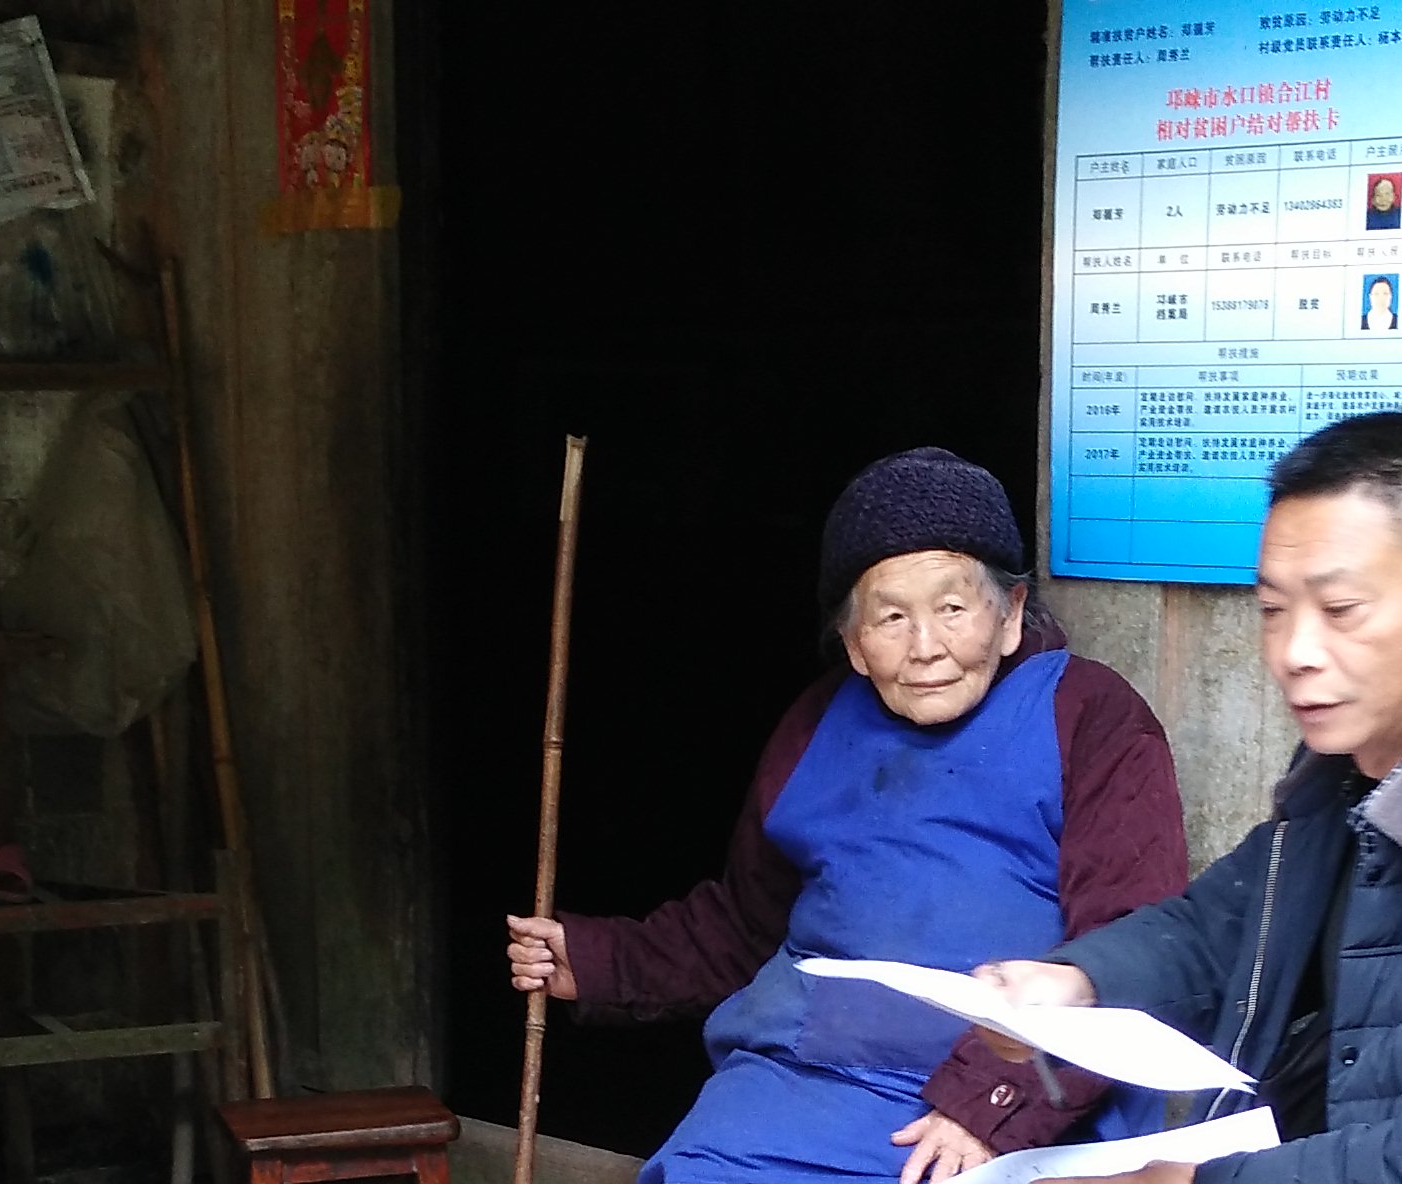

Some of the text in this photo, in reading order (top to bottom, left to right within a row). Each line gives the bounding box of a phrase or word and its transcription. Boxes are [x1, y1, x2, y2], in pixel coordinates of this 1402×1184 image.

[1166, 77, 1331, 110] 邛崃市水口镇合江村
[1157, 107, 1340, 141] 相对贫困户结对帮扶卡
